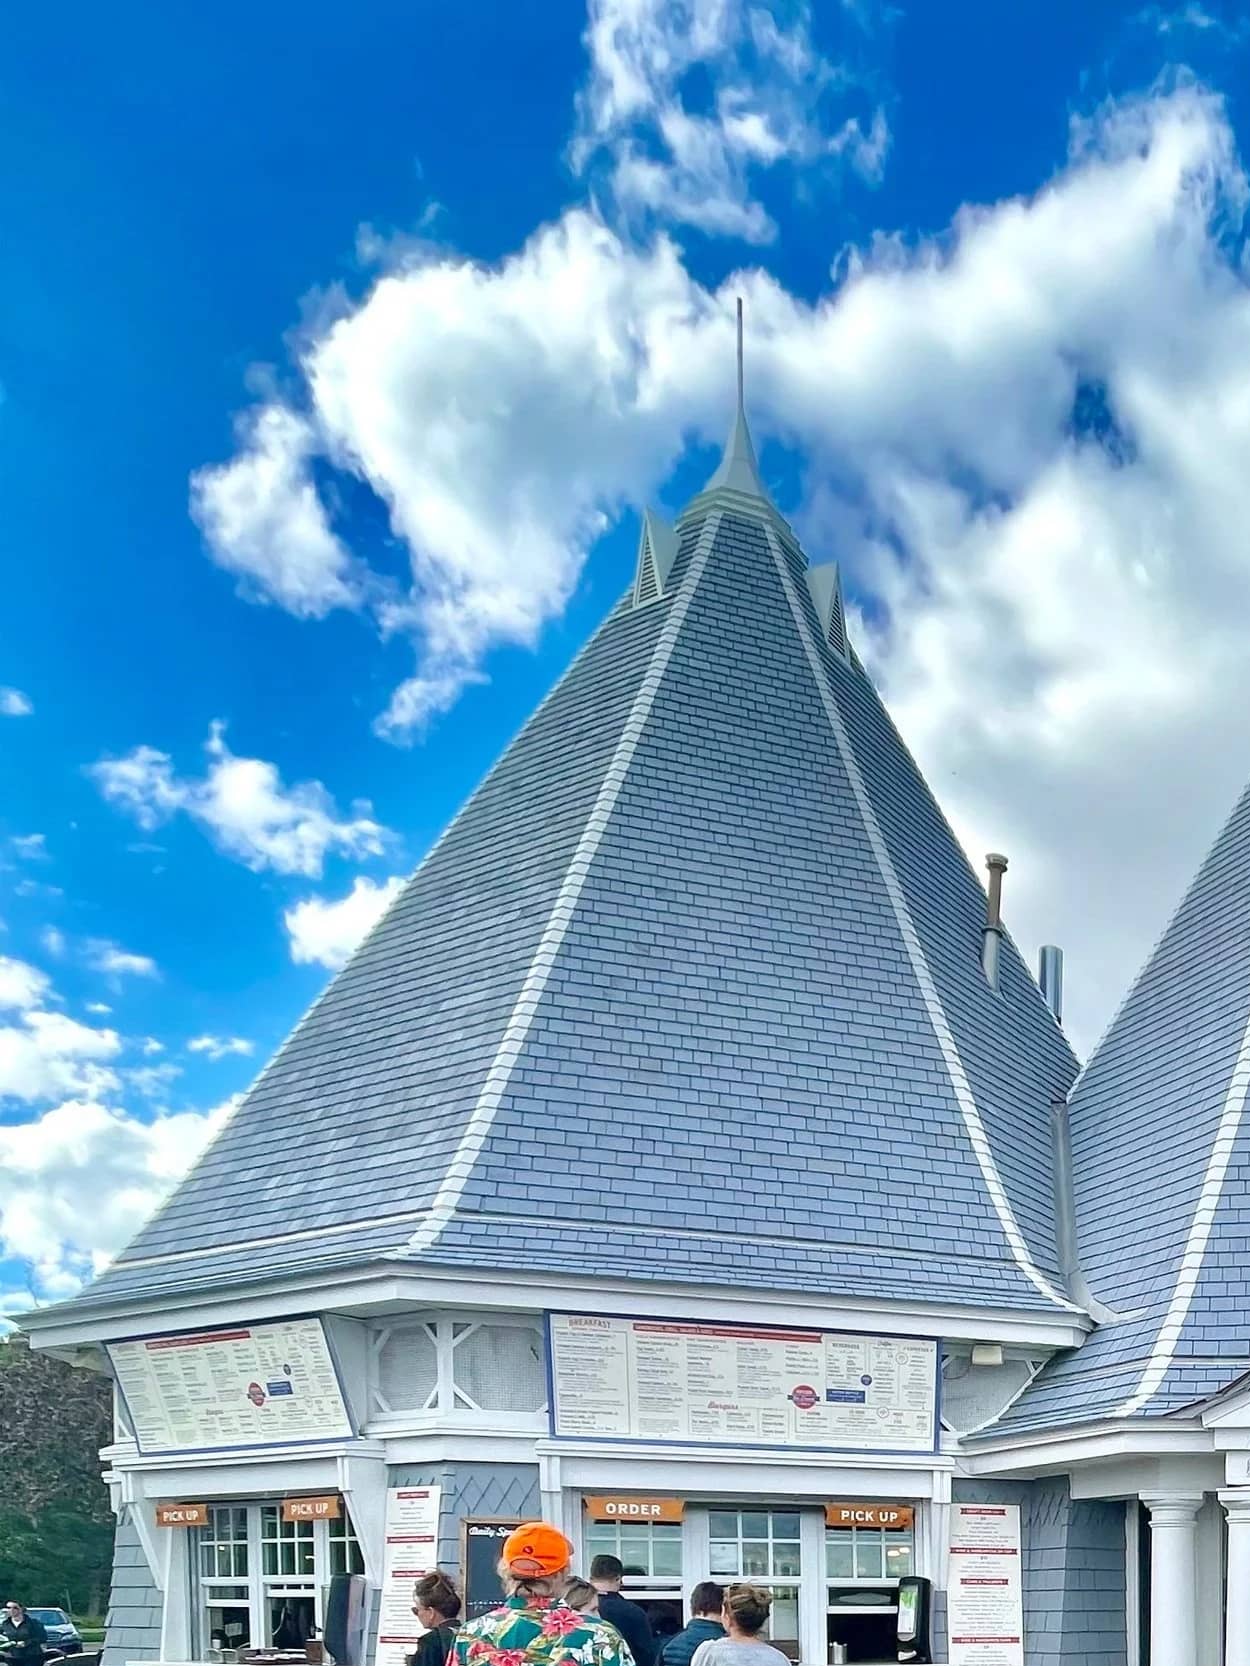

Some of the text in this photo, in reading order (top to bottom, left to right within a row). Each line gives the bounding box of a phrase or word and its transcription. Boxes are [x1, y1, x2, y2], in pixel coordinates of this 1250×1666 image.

[290, 1502, 329, 1516] PICK UP
[605, 1502, 661, 1515] ORDER
[163, 1509, 199, 1522] PICK UP
[840, 1510, 898, 1523] PICK UP
